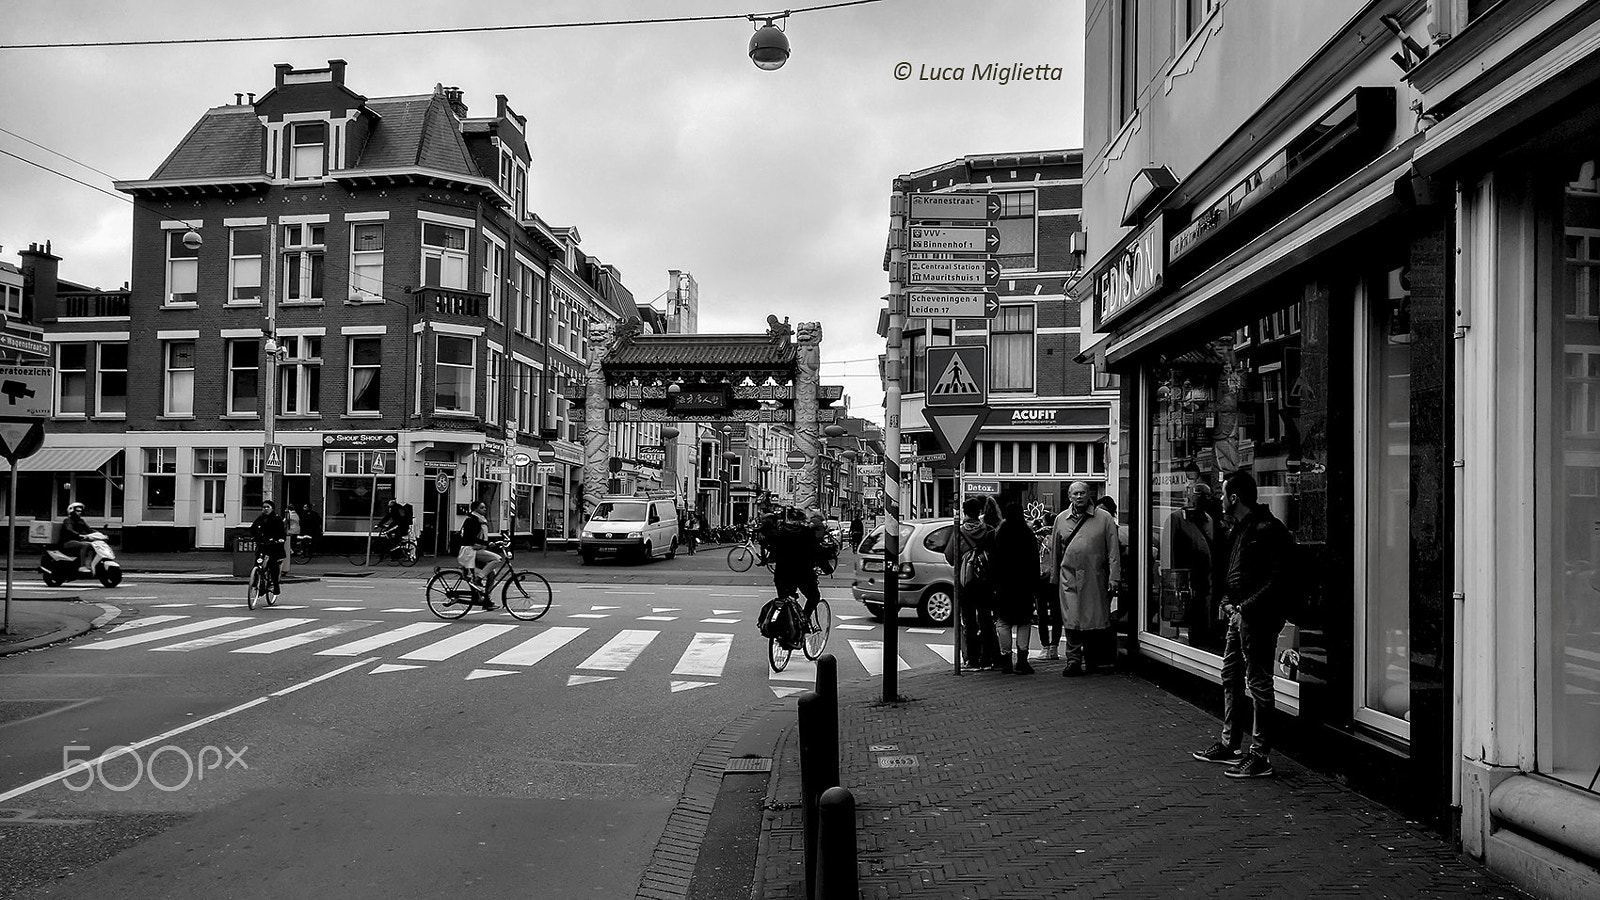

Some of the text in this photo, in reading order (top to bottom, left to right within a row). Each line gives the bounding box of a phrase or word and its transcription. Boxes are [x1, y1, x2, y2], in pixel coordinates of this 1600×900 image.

[923, 196, 974, 205] Kranestraat
[923, 229, 941, 237] VVV
[923, 240, 967, 248] Binnenhof
[923, 273, 974, 281] Mauritshuis
[1100, 232, 1155, 324] EDISON
[911, 294, 978, 304] Scheveningen 4
[1011, 409, 1058, 420] ACUFIT
[967, 483, 995, 492] Detox.
